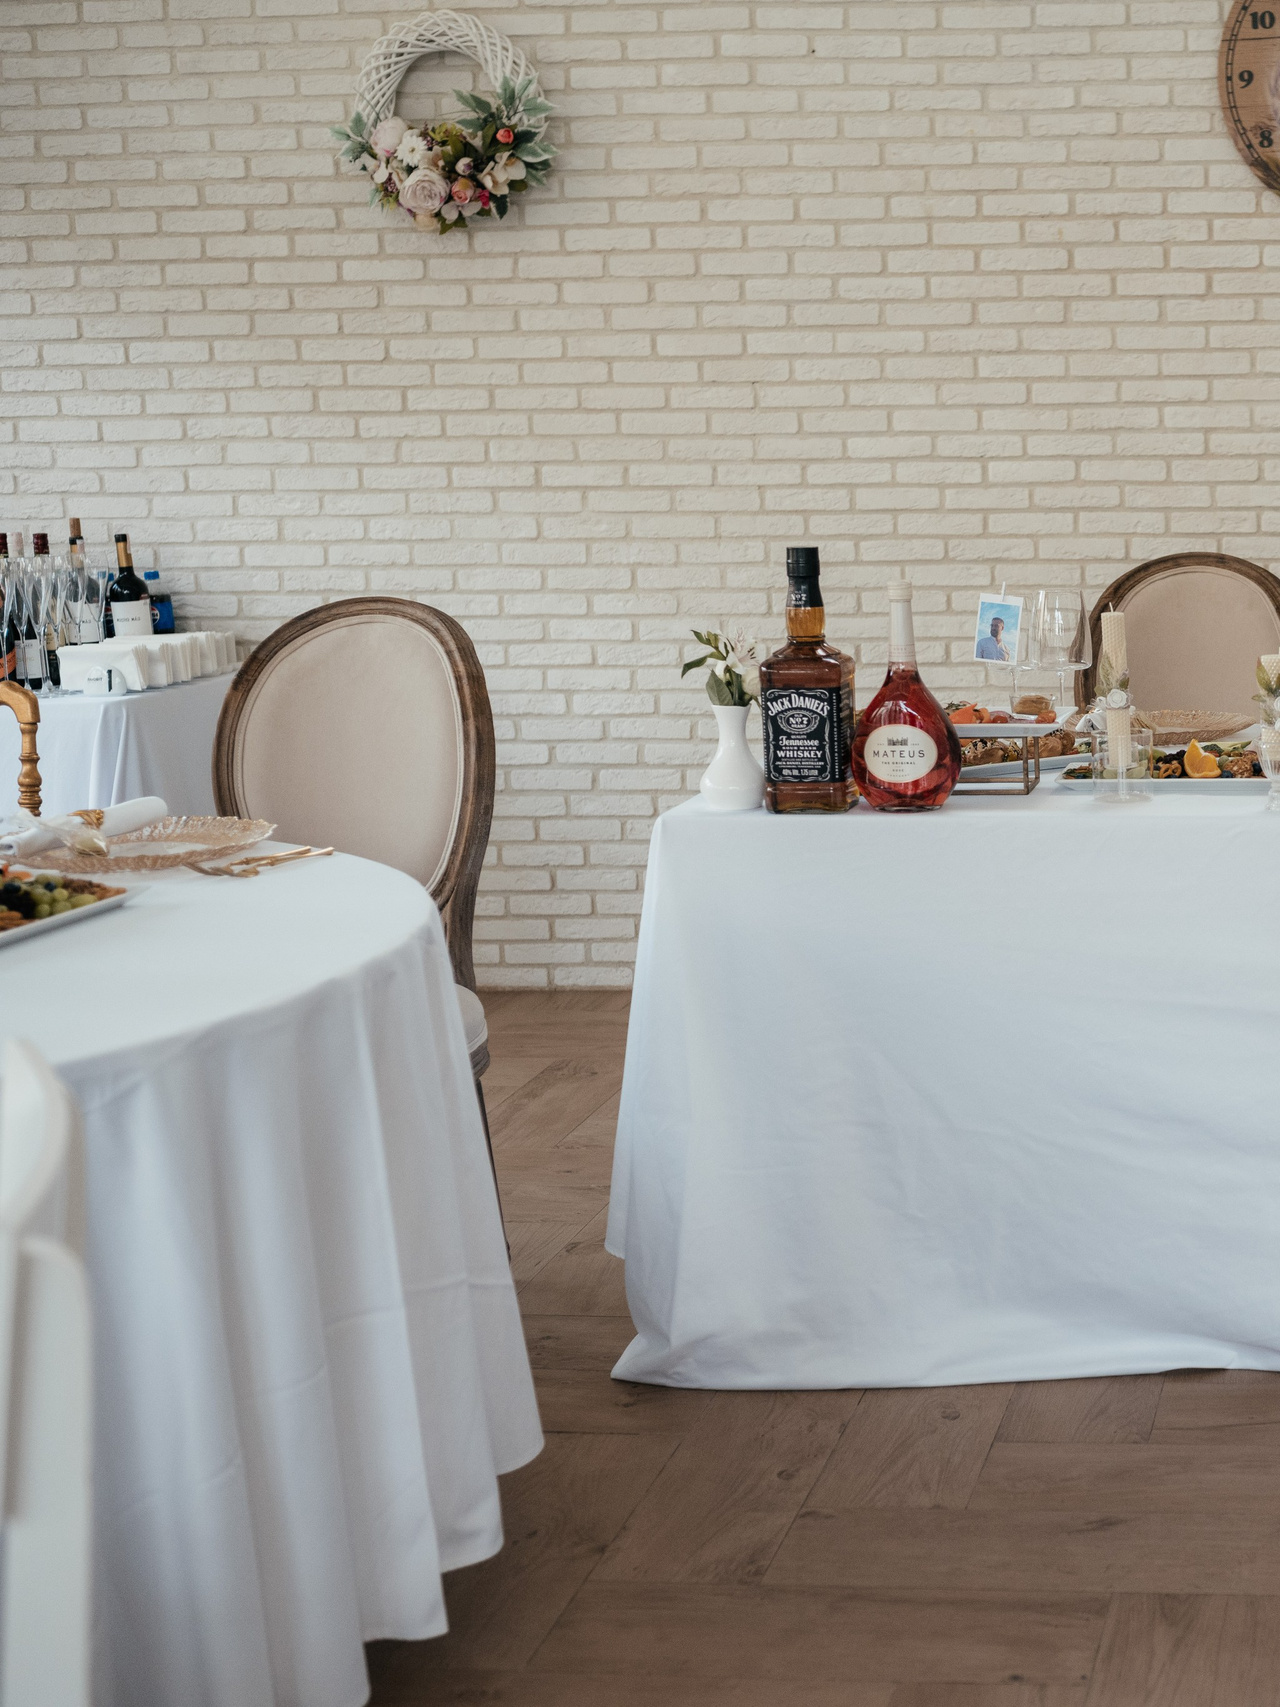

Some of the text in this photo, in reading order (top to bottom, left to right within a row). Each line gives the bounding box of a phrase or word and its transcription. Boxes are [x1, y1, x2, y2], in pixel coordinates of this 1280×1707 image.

[1250, 10, 1276, 30] 10
[1239, 70, 1254, 88] 9
[1259, 130, 1274, 148] 8
[767, 694, 830, 717] JACK DANIEL'S
[779, 736, 819, 746] Tennessee
[873, 750, 925, 758] MATEUS
